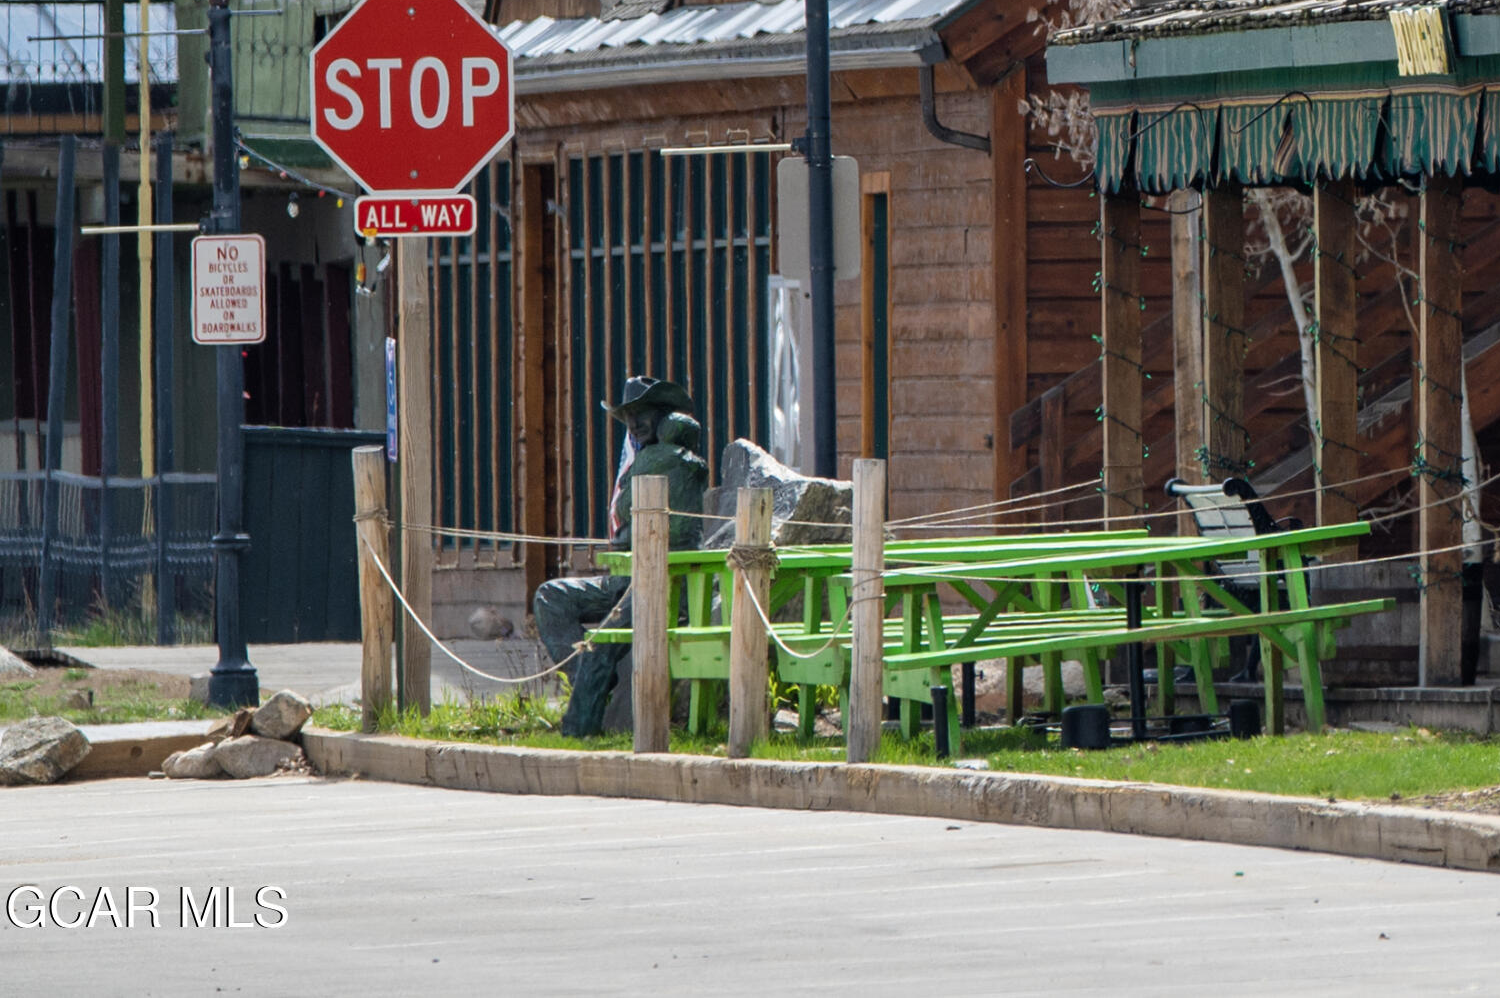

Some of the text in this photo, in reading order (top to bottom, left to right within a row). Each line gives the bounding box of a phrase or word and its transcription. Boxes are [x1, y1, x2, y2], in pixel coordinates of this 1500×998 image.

[323, 56, 500, 131] STOP
[366, 204, 464, 228] ALL WAY
[217, 246, 239, 261] NO
[208, 263, 248, 273] BICYCLES
[222, 275, 234, 284] OR
[200, 286, 257, 297] SKATEBOARDS
[210, 299, 248, 309] ALLOWED
[223, 311, 235, 320] ON
[202, 323, 257, 334] BOARDWALKS
